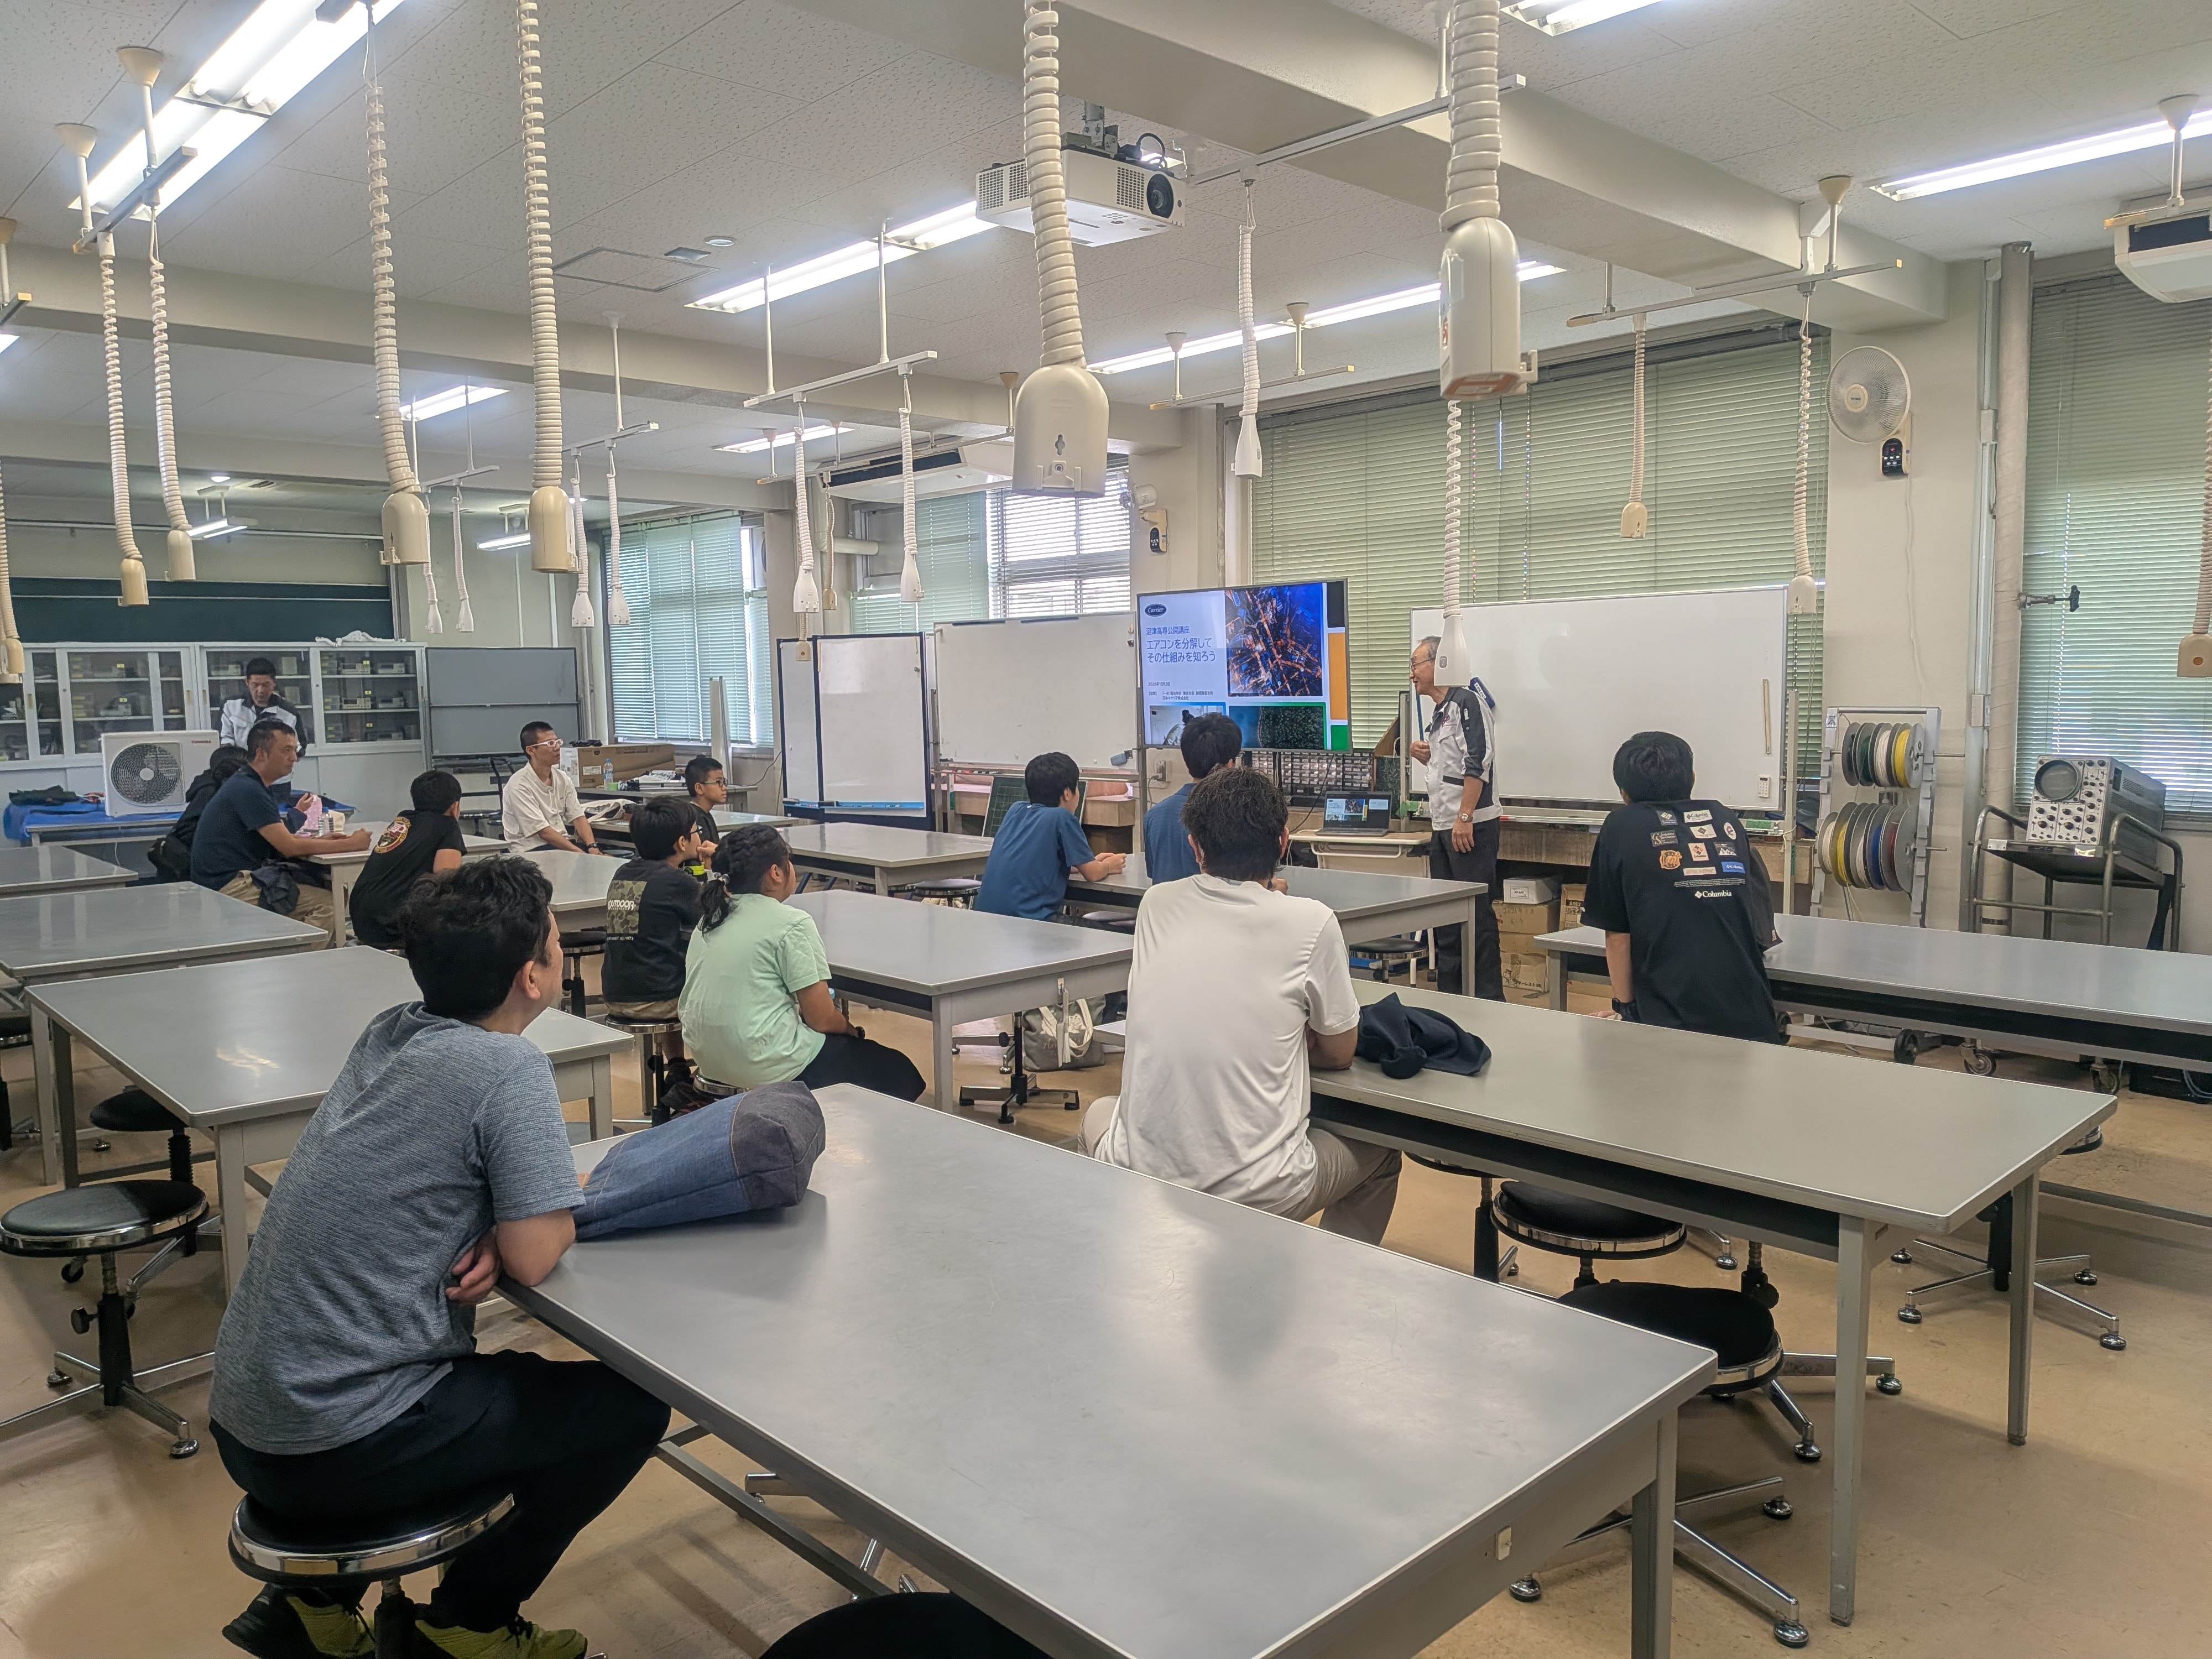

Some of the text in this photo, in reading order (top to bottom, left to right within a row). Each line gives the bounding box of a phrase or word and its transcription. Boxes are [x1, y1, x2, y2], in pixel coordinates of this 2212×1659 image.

[1146, 626, 1190, 635] 沼津高専公開講座
[1146, 638, 1212, 649] エアコンを分解して
[1147, 651, 1216, 663] その仕組みを知ろう
[608, 900, 634, 911] OUTDOOR
